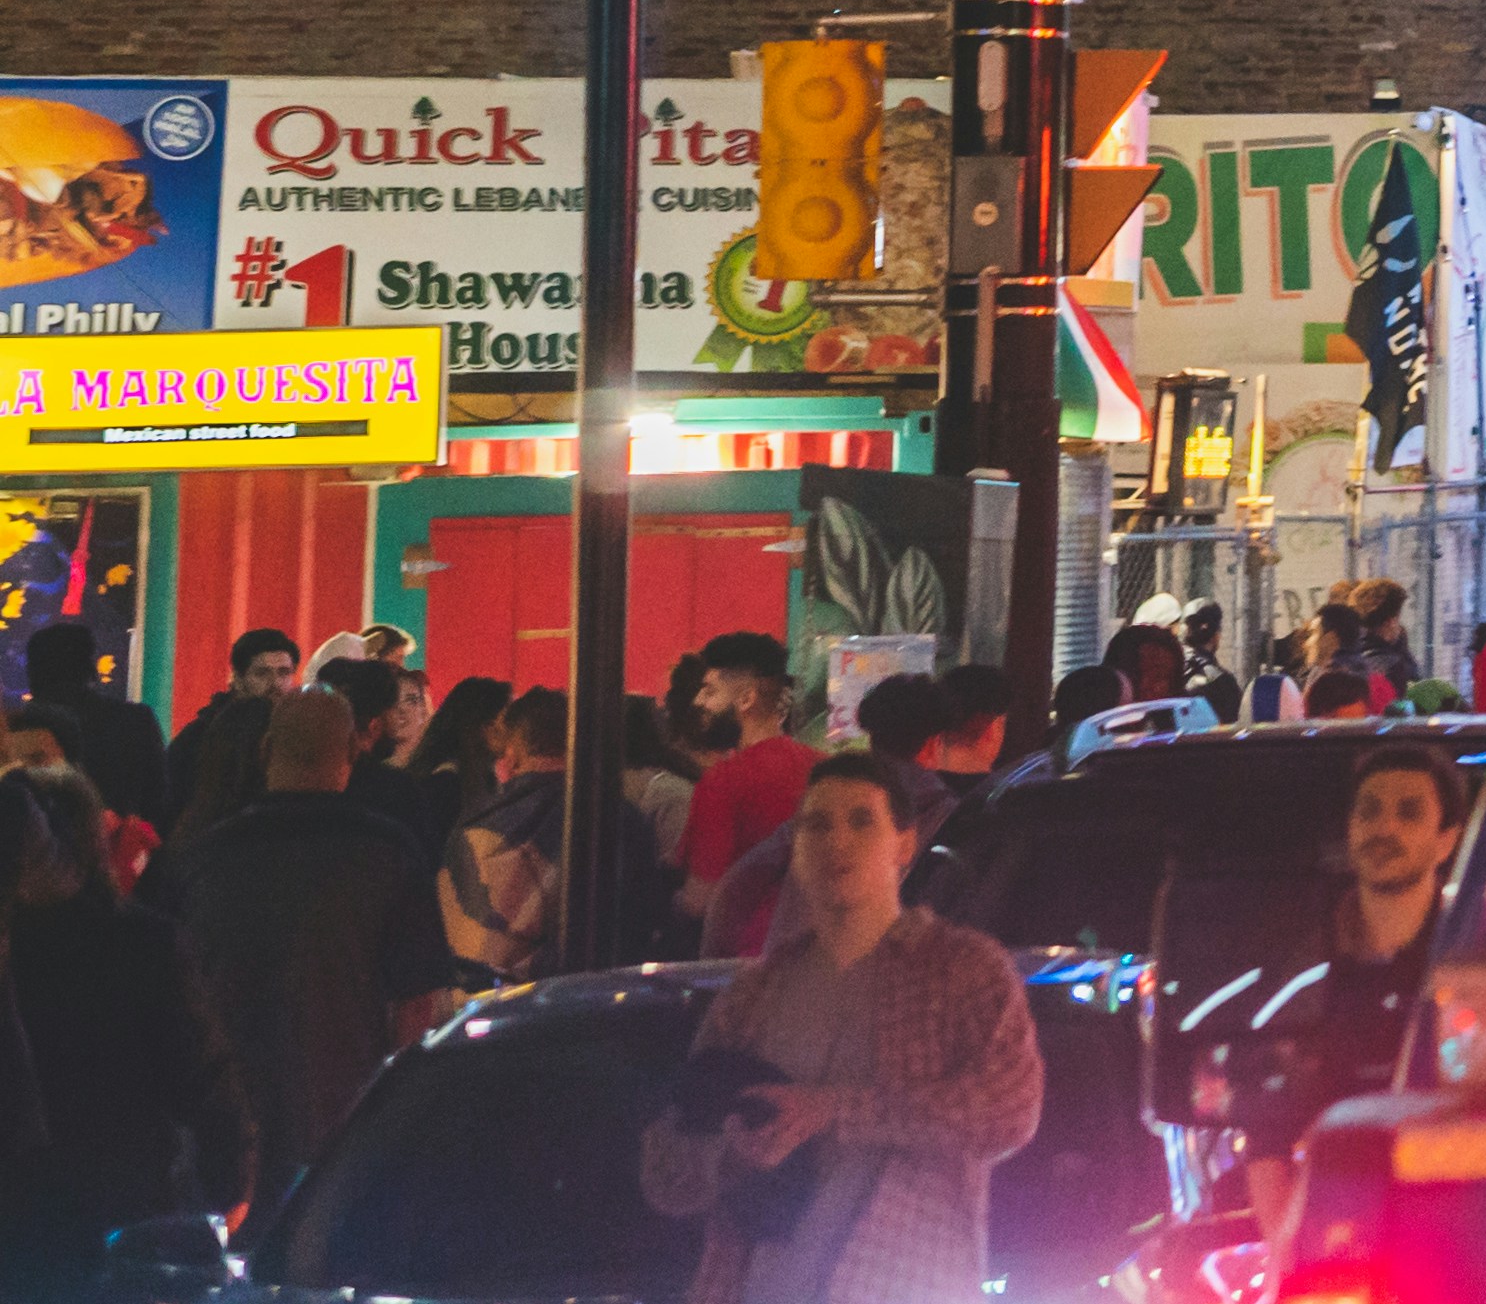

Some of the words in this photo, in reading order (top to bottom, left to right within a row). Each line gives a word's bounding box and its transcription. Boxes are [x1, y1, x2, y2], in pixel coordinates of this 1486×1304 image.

[254, 103, 545, 181] Quick
[638, 99, 761, 167] ita
[238, 187, 438, 214] AUTHENTIC
[69, 355, 421, 412] MARQUESITA
[103, 425, 186, 444] Mexican
[189, 424, 249, 441] street
[250, 422, 297, 439] food
